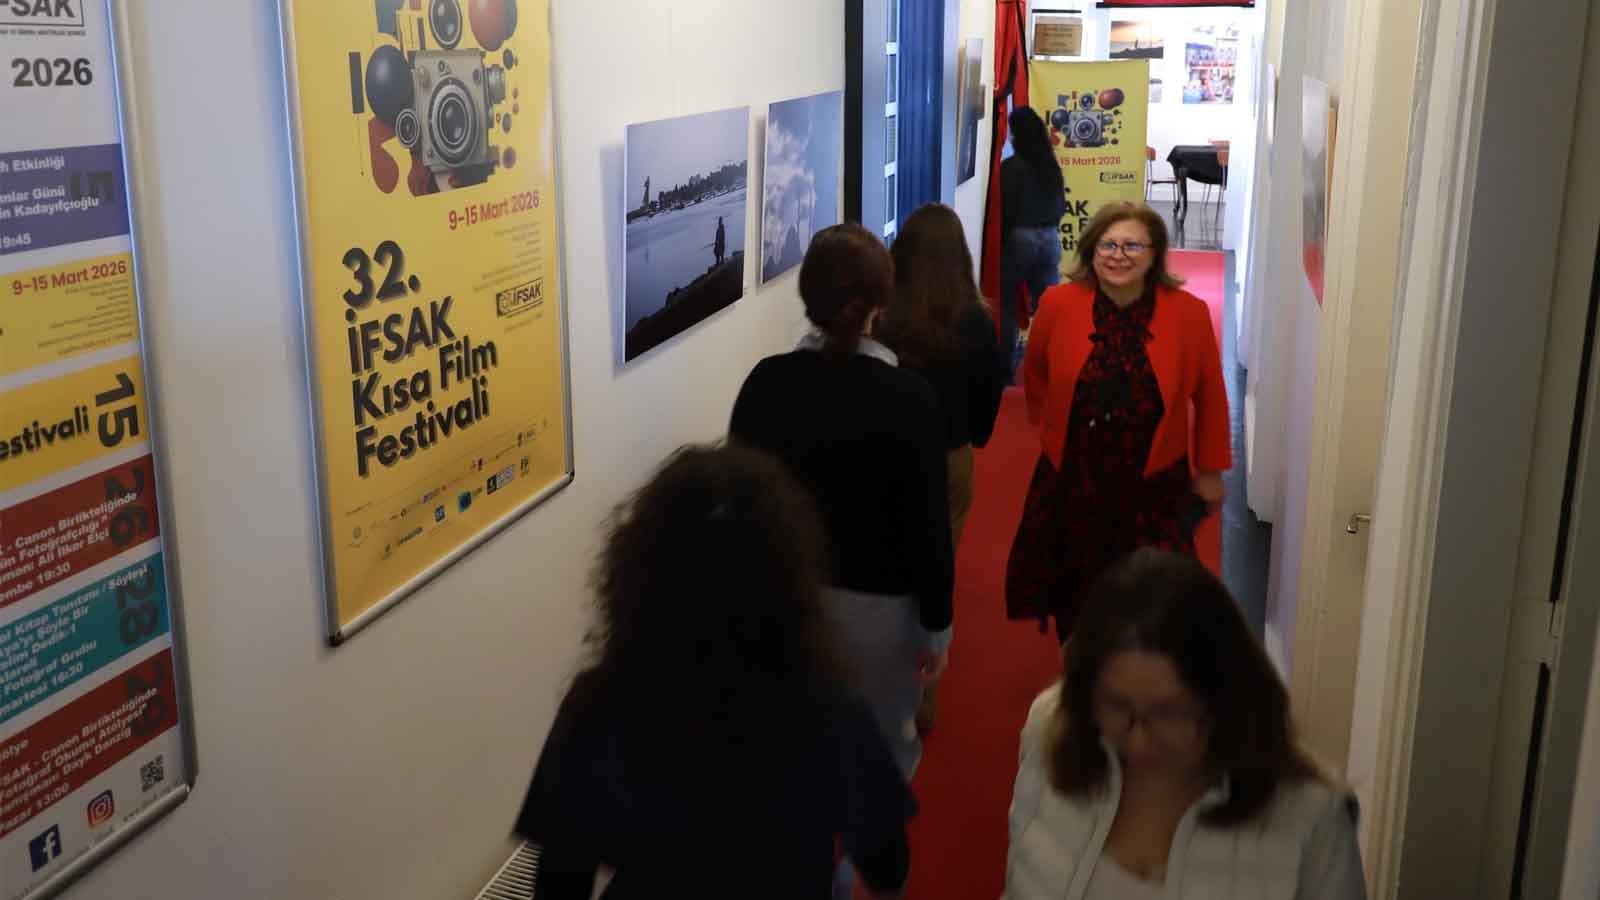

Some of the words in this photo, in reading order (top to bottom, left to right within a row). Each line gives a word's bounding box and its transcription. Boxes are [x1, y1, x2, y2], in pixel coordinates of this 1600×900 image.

[0, 0, 76, 18] SAK
[11, 57, 93, 87] 2026
[13, 155, 65, 171] Etkinliği
[1072, 157, 1097, 166] Mart
[1098, 155, 1121, 166] 2026
[32, 186, 65, 200] Günü
[449, 205, 478, 230] 9-15
[480, 201, 509, 222] Mart
[511, 190, 540, 213] 2026
[12, 272, 49, 296] 9-15
[51, 268, 88, 288] Mart
[90, 260, 127, 280] 2026
[342, 240, 420, 309] 32.
[344, 296, 455, 376] İFSAK
[352, 372, 432, 426] Kısa
[439, 335, 498, 390] Film
[95, 372, 139, 448] 15
[355, 376, 489, 479] Festivali
[15, 527, 56, 549] Canon
[38, 551, 54, 568] Ali
[42, 734, 80, 763] Canon
